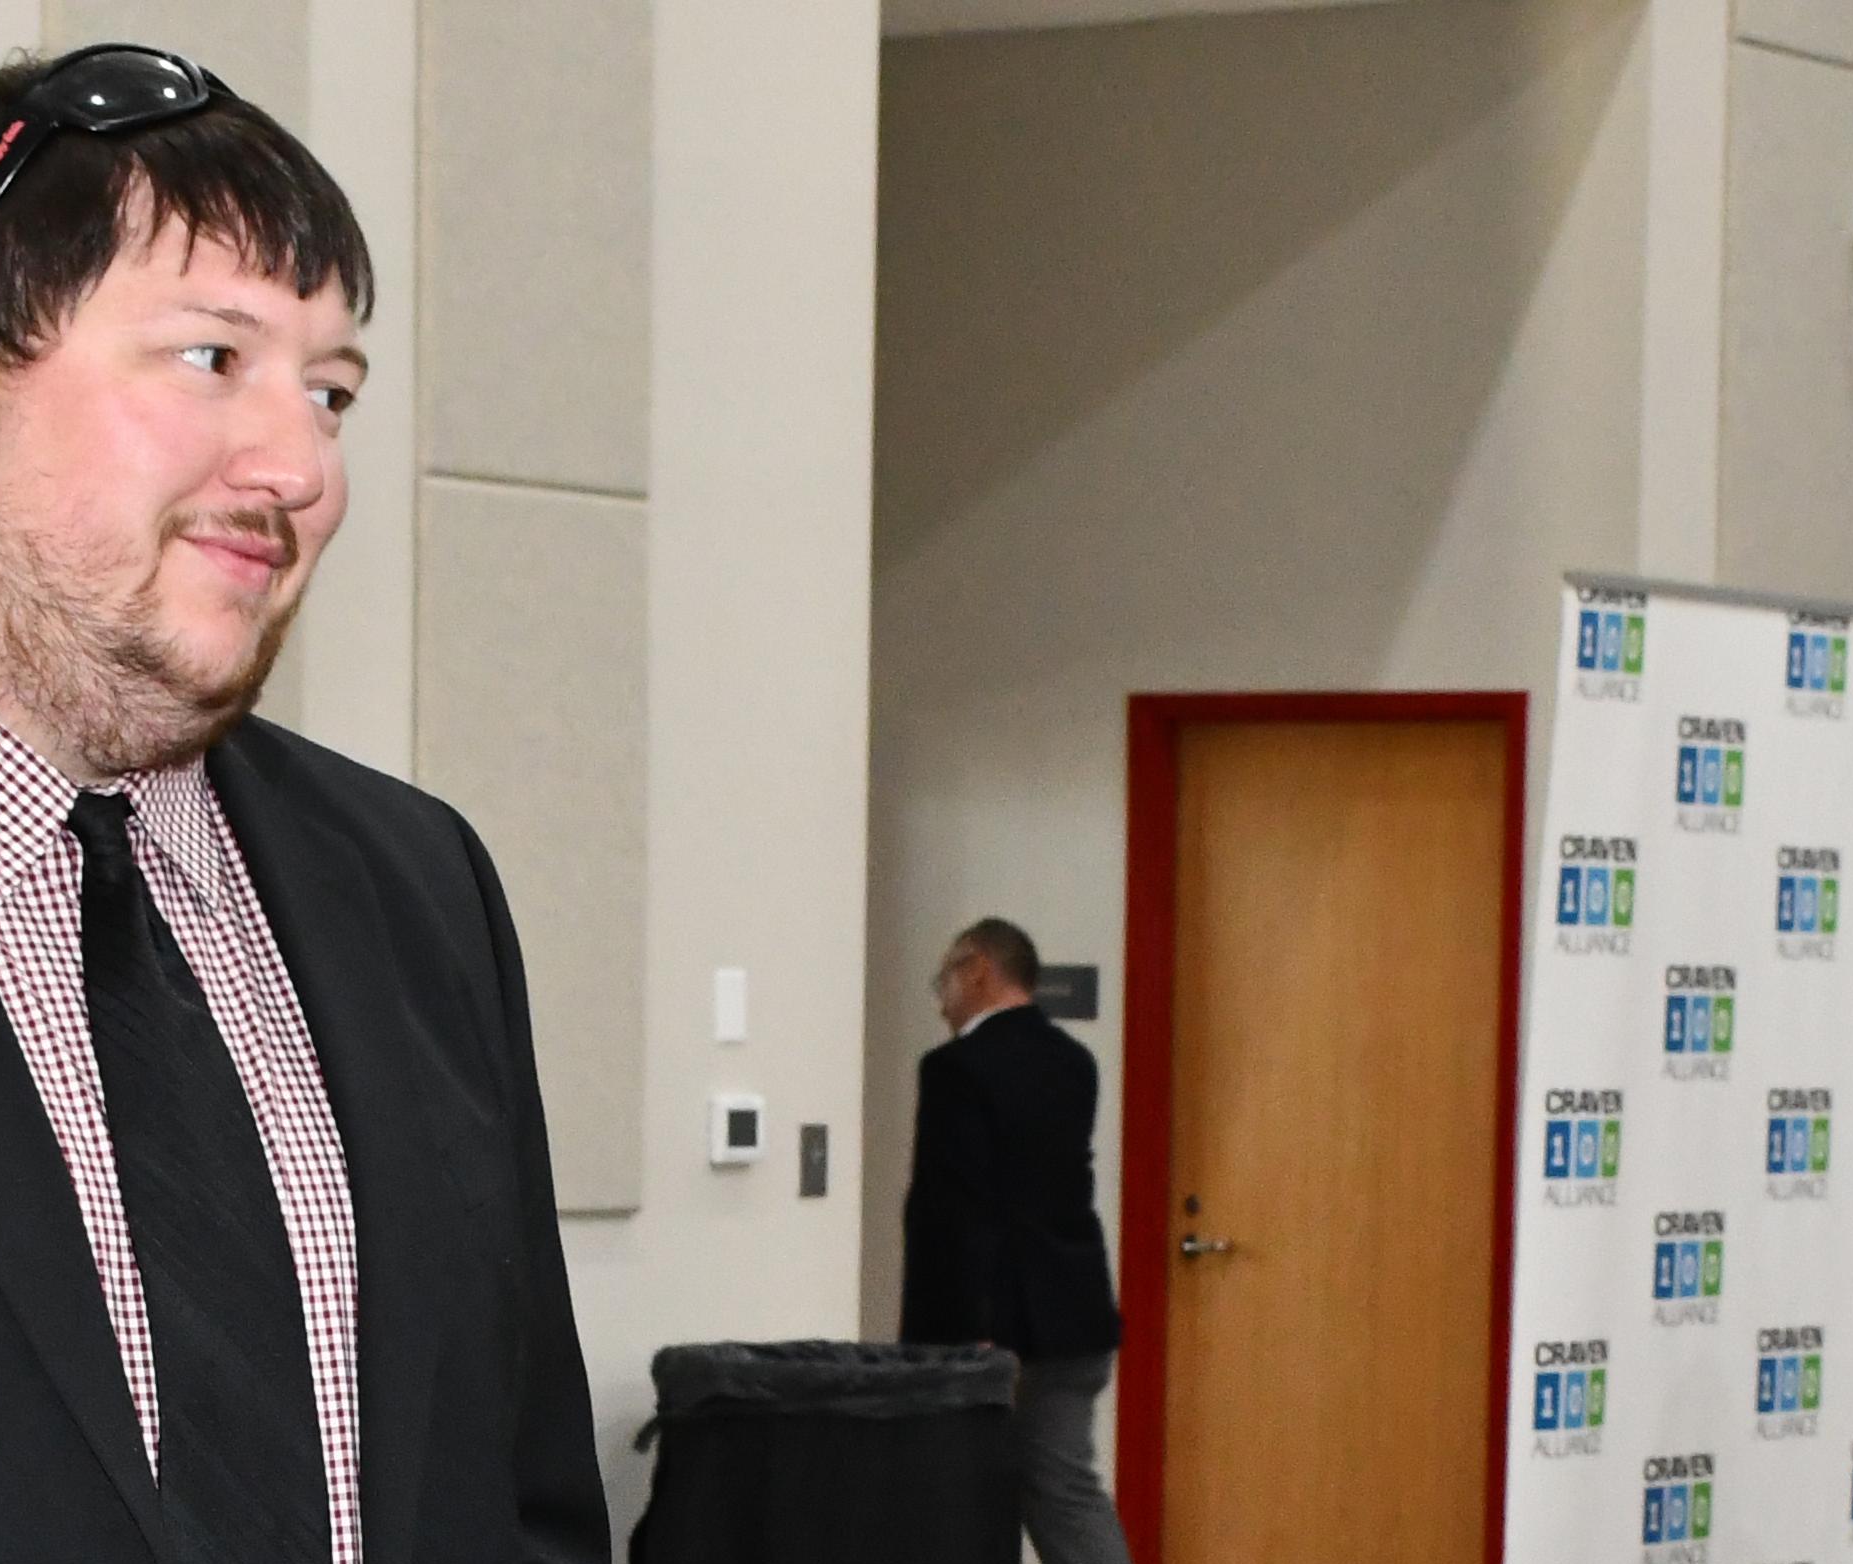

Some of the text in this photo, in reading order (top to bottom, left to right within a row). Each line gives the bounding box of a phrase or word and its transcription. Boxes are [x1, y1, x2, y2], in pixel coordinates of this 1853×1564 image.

[1679, 716, 1745, 742] CRAVEN
[1560, 835, 1636, 861] CRAVEN
[1778, 847, 1839, 872] CRAVEN
[1666, 966, 1735, 990] CRAVEN
[1546, 1090, 1623, 1114] CRAVEN
[1768, 1088, 1830, 1112] CRAVEN
[1655, 1211, 1724, 1237] CRAVEN
[1758, 1327, 1823, 1352] CRAVEN
[1535, 1340, 1607, 1367] CRAVEN
[1646, 1455, 1713, 1481] CRAVEN
